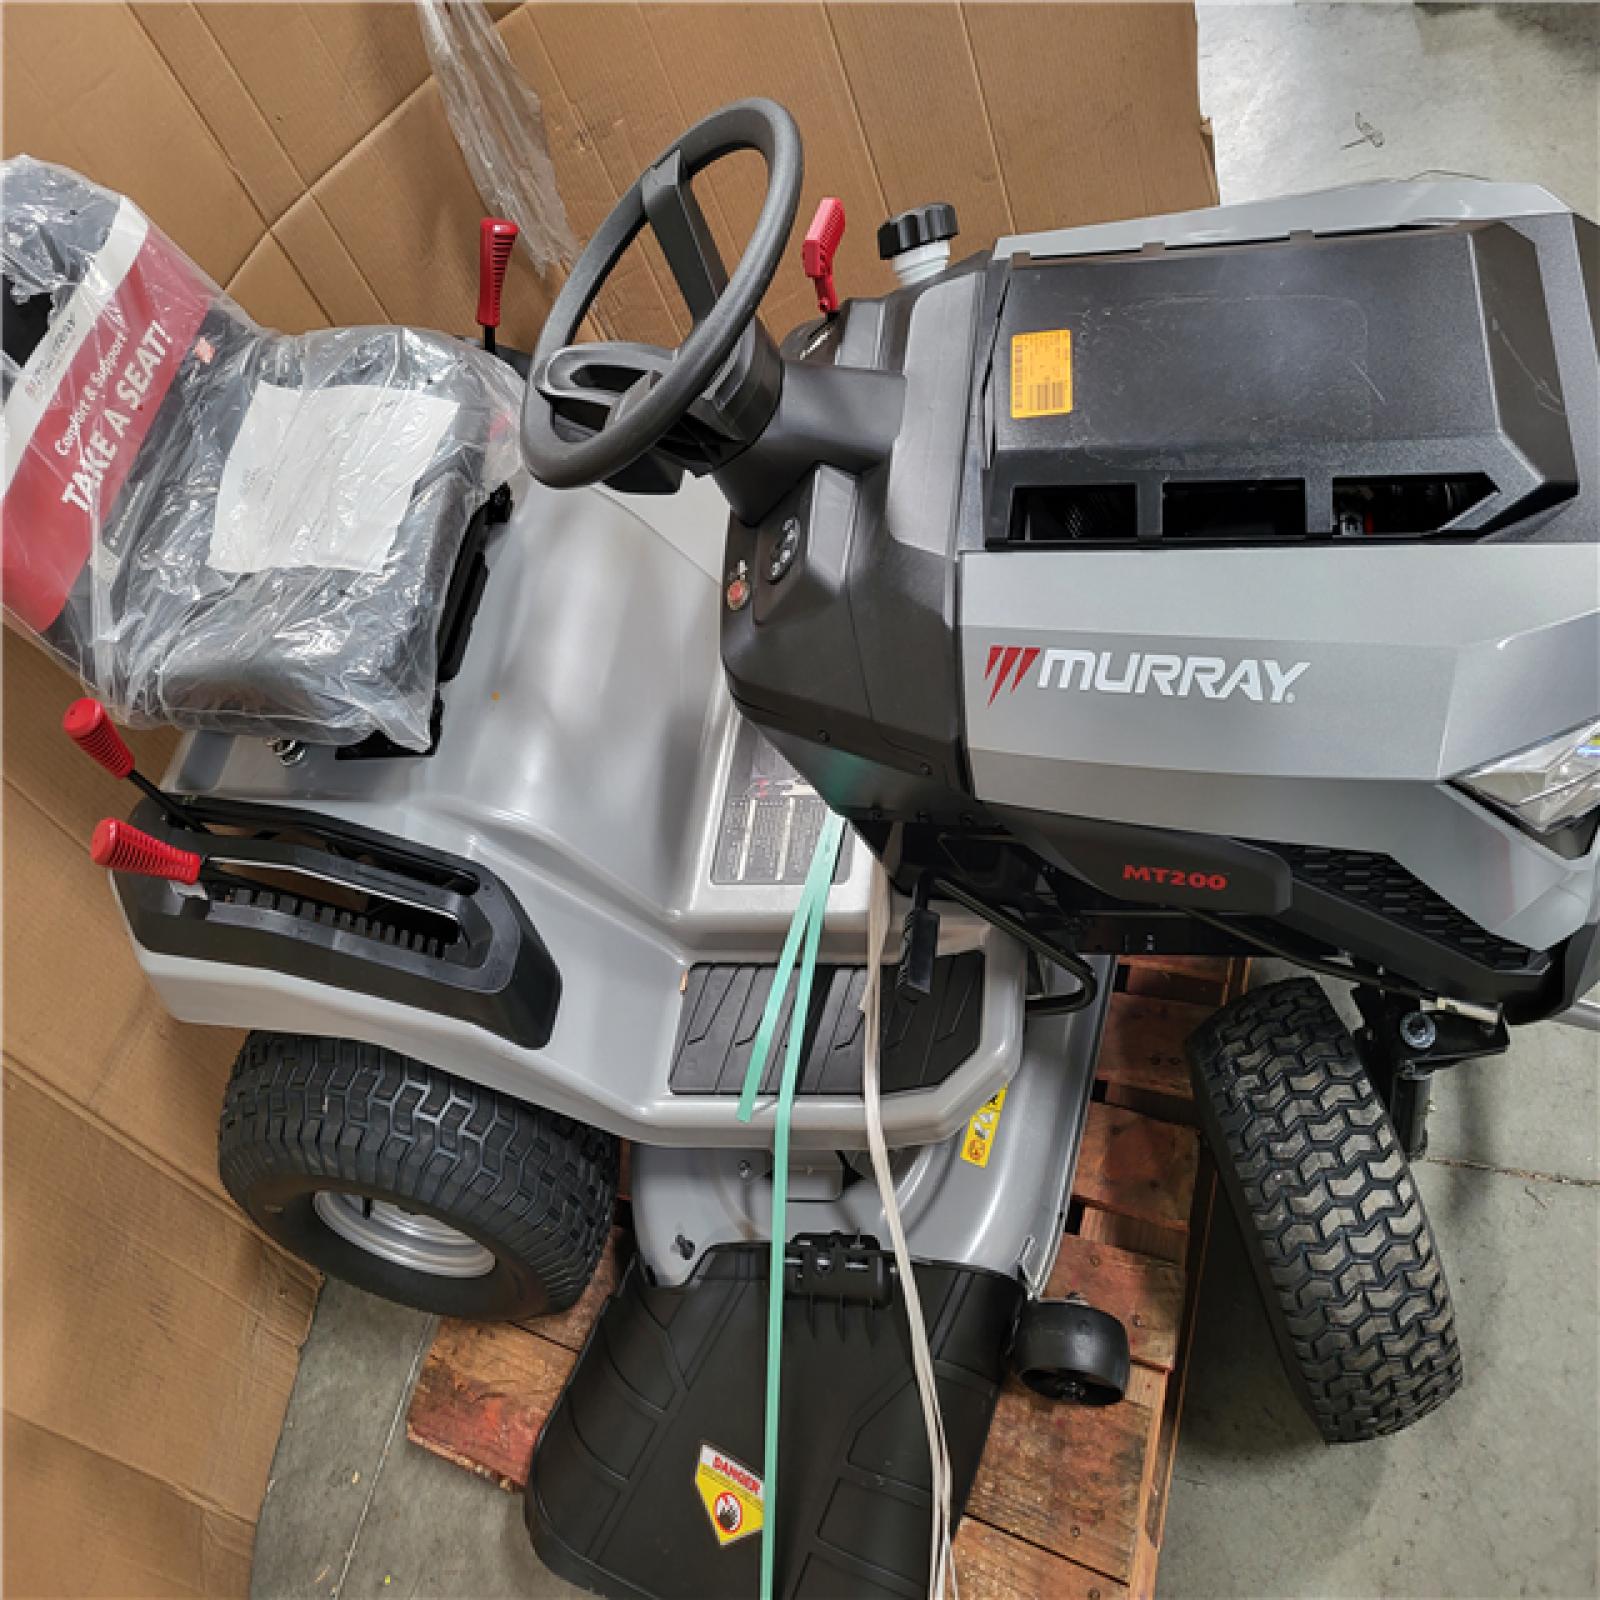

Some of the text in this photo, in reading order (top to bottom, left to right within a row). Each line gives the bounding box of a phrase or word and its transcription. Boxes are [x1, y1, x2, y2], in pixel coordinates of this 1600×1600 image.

[116, 319, 173, 411] SEAT!
[104, 408, 131, 438] A
[61, 430, 117, 512] TAKE
[1037, 648, 1312, 704] MURRAY
[1122, 863, 1228, 892] MT200
[712, 1454, 762, 1495] DANGER
